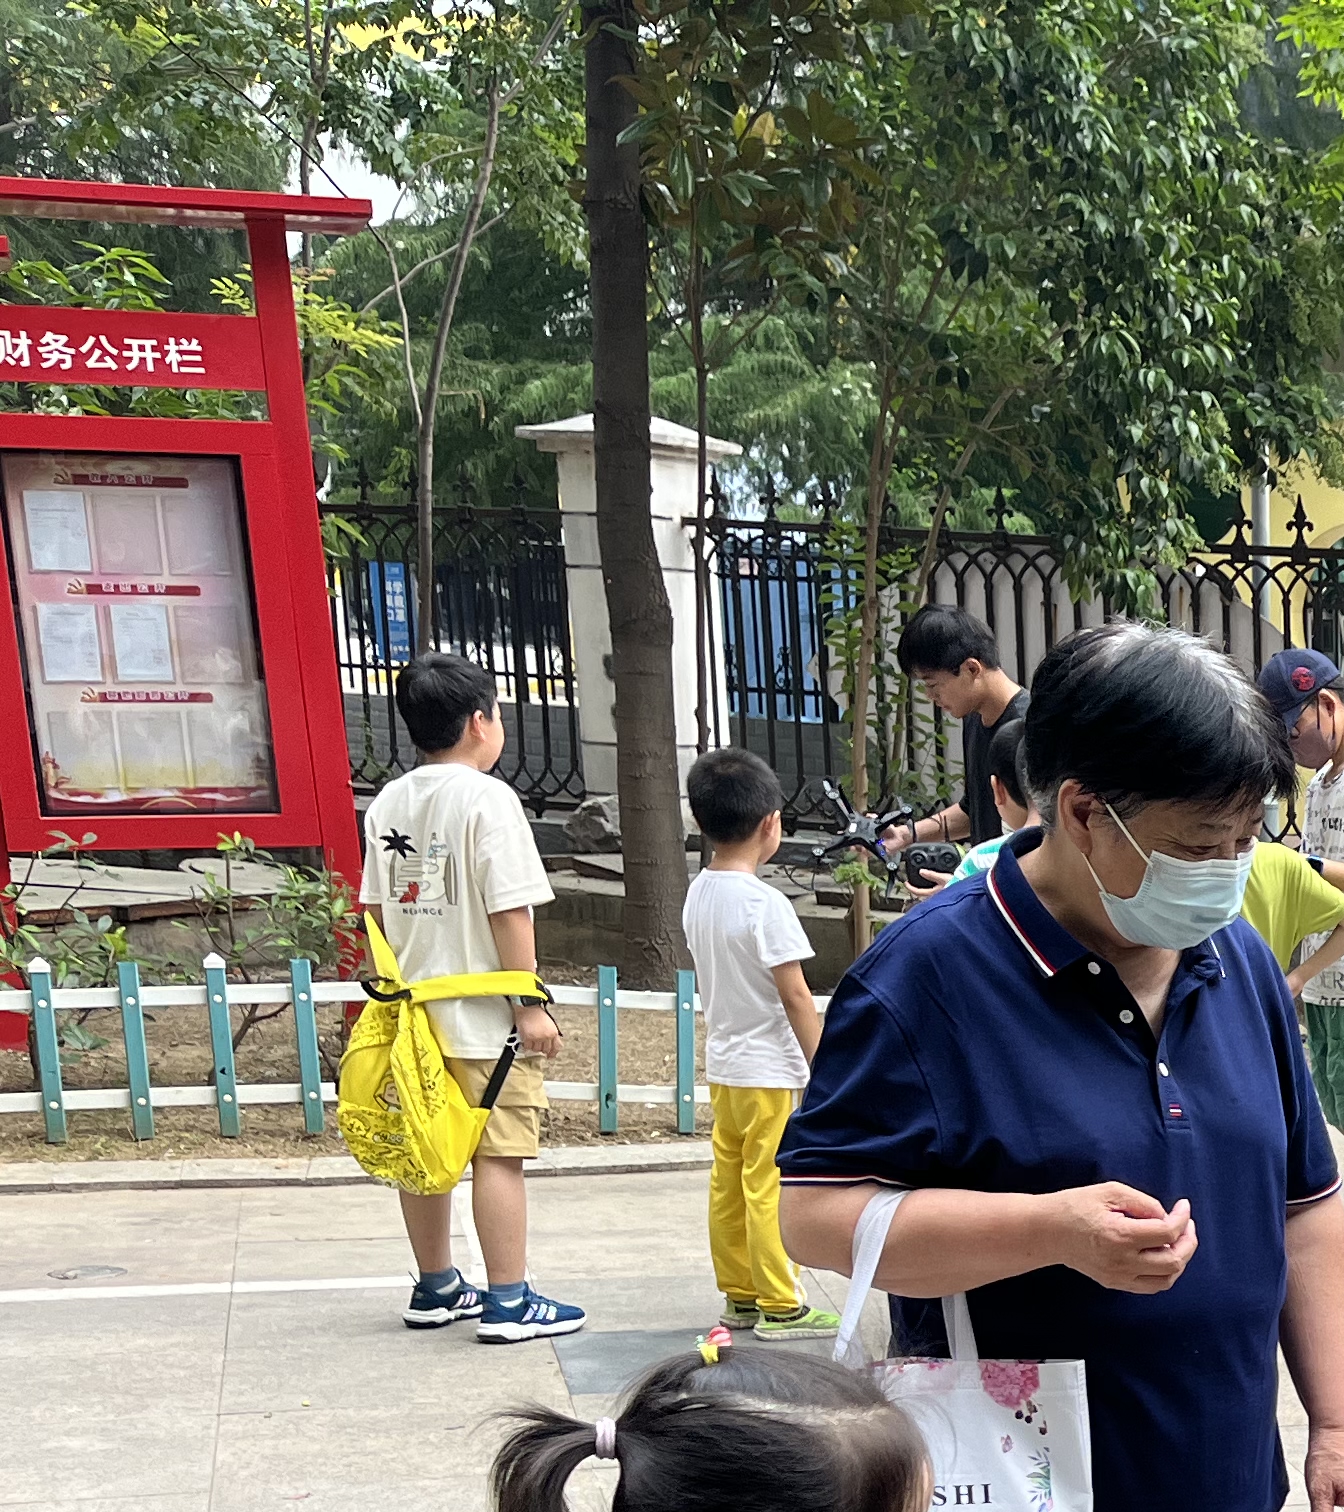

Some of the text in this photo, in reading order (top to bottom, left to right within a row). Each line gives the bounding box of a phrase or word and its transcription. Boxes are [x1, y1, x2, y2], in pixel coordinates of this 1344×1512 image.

[0, 330, 206, 374] 财务公开栏
